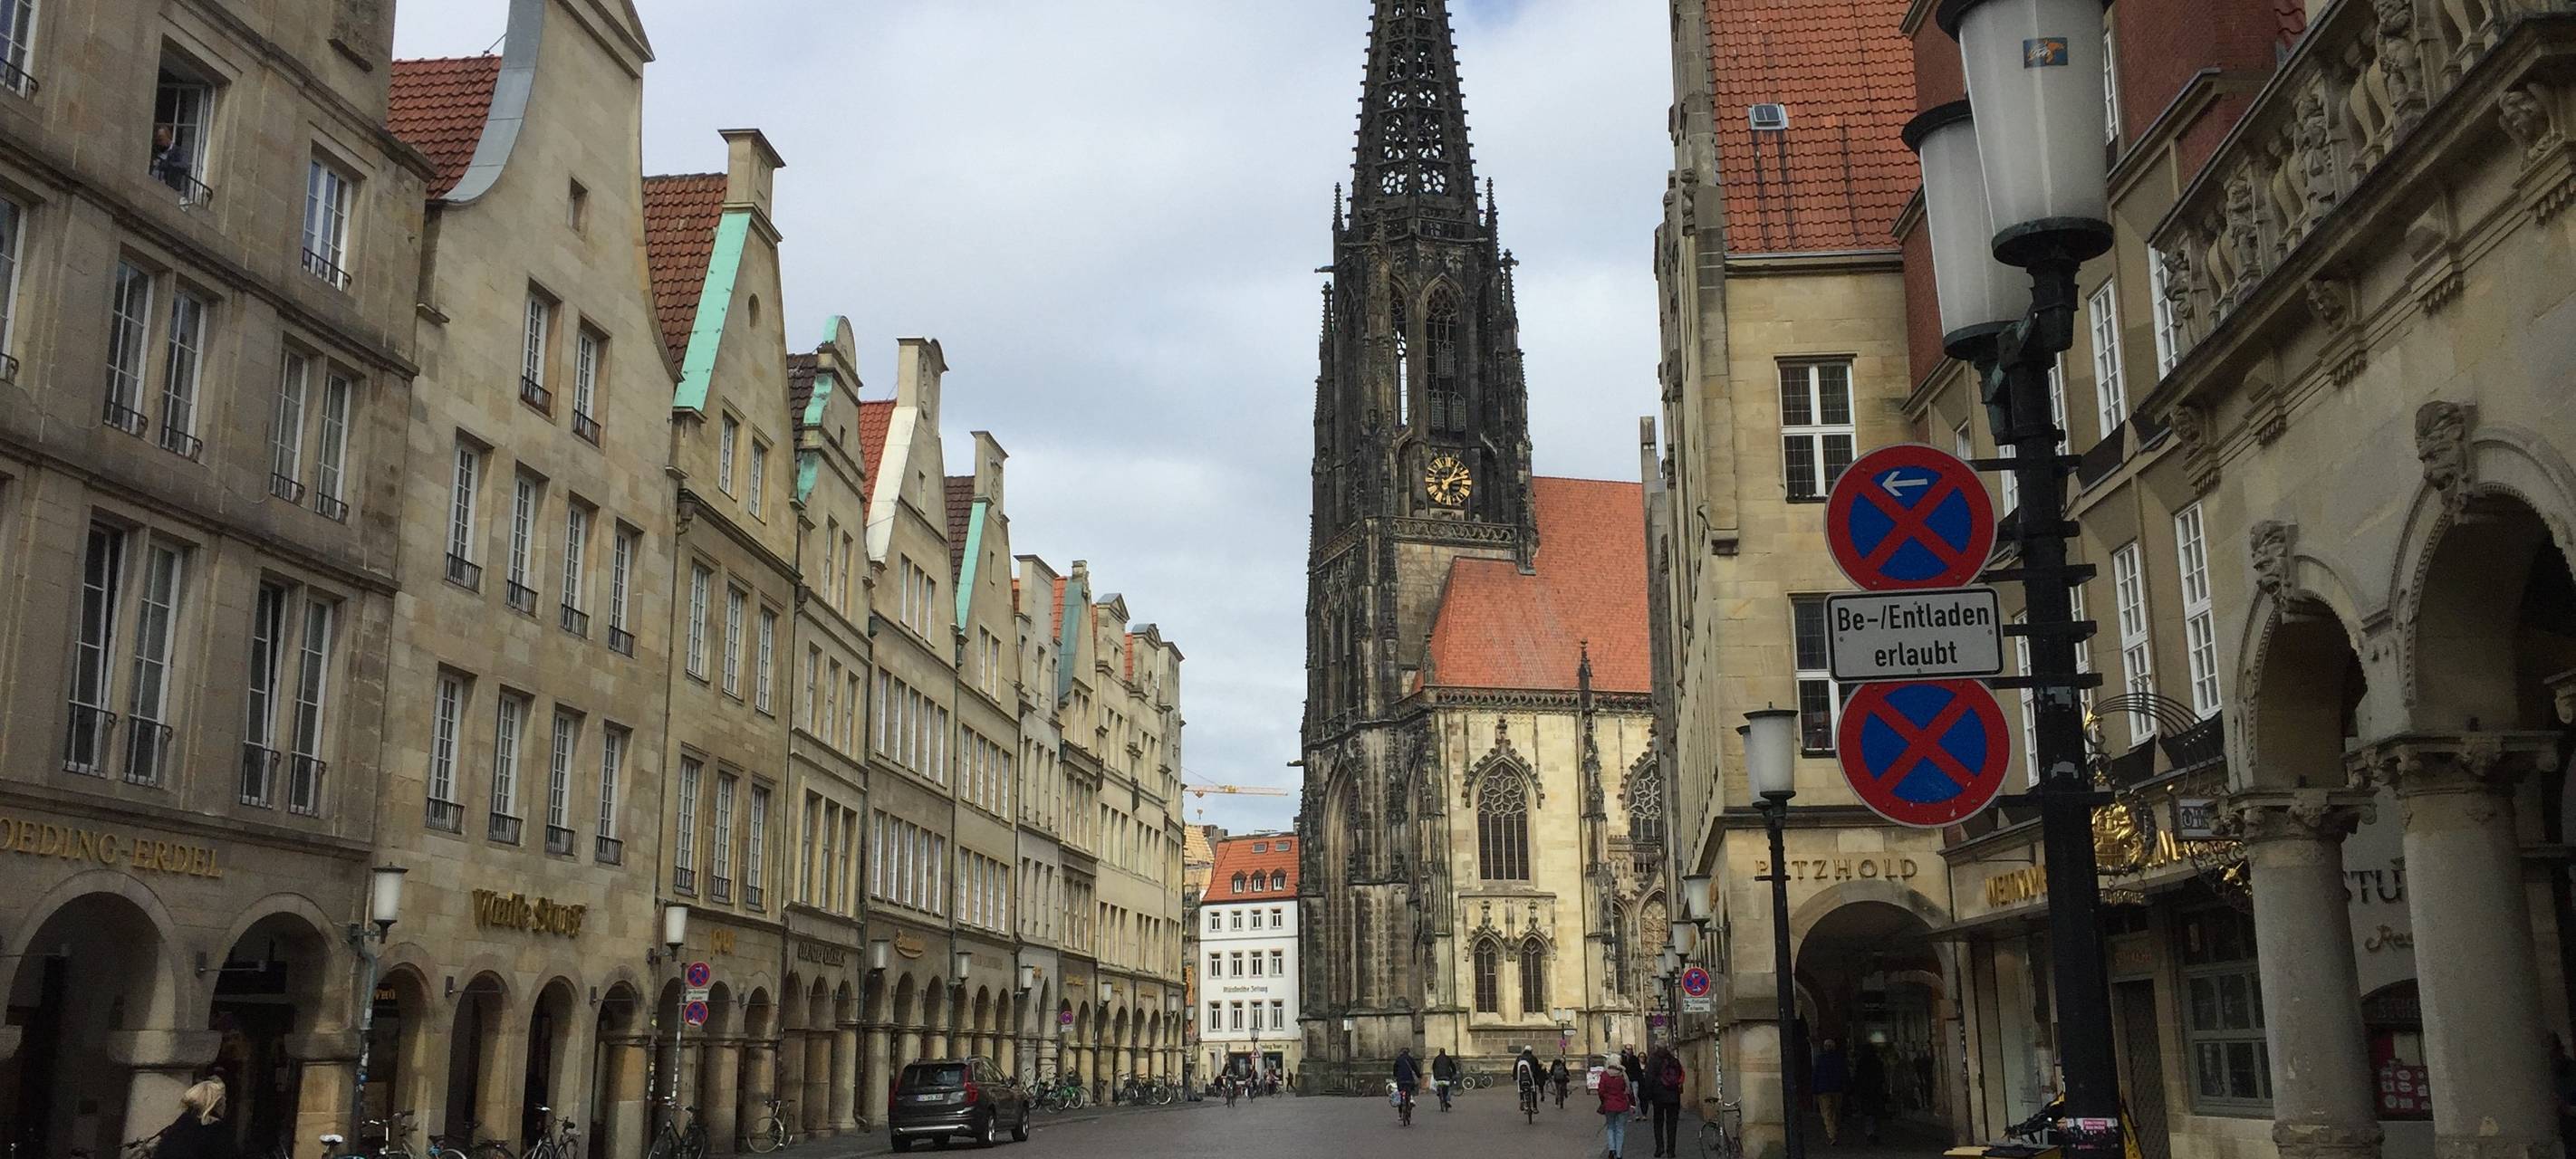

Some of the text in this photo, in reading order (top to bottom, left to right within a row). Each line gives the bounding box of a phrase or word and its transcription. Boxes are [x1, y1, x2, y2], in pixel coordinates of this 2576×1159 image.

[1837, 602, 1990, 632] Be-/Entladen
[1874, 640, 1957, 666] erlaubt
[1755, 858, 1918, 881] PTZHOLD
